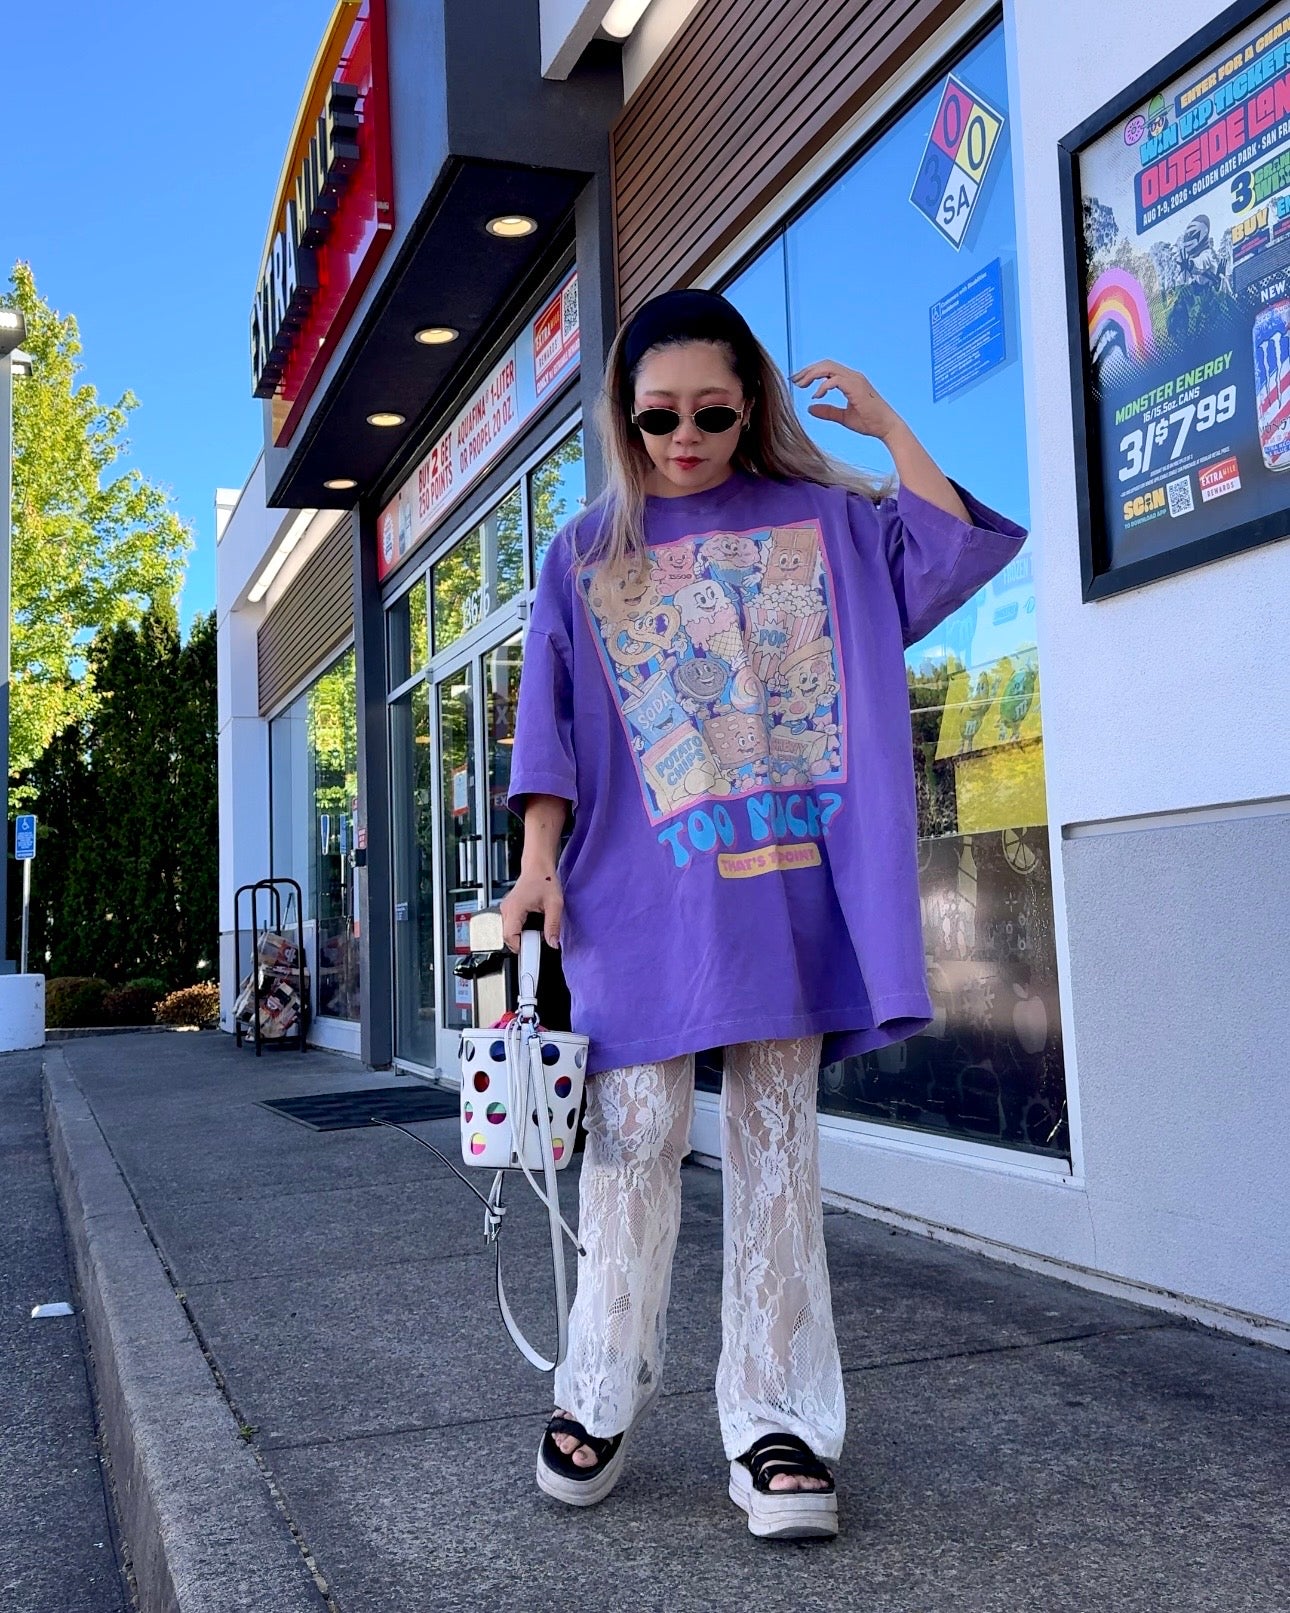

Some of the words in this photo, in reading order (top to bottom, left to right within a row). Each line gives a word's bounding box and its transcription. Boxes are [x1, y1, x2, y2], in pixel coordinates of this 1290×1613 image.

[1180, 73, 1217, 109] ENTER
[1218, 53, 1243, 80] FOR
[1245, 44, 1254, 62] A
[943, 94, 961, 148] 0
[967, 115, 986, 170] 0
[1141, 106, 1245, 208] OUTSIDE
[1143, 209, 1156, 226] AUG
[1170, 189, 1188, 208] 2026
[1192, 173, 1219, 196] GOLDEN
[1220, 159, 1237, 178] GATE
[1237, 142, 1257, 166] PARK
[1261, 129, 1277, 150] SAN
[925, 154, 941, 207] 3
[1231, 171, 1254, 215] 3
[943, 184, 970, 225] SA
[1231, 207, 1269, 245] BUY
[1260, 280, 1286, 302] NEW
[491, 360, 514, 406] 1-LITER
[1115, 381, 1174, 426] MONSTER
[1175, 351, 1233, 393] ENERGY
[1178, 386, 1201, 406] CANS
[418, 464, 430, 493] BUY
[431, 447, 438, 477] 2
[440, 432, 452, 467] GET
[460, 447, 468, 474] OR
[469, 426, 492, 459] PROPEL
[493, 410, 501, 437] 20
[431, 463, 453, 507] POINTS
[1123, 487, 1166, 521] SCAN
[1207, 482, 1235, 498] REWARDS
[758, 628, 786, 650] POP
[637, 690, 674, 730] SODA
[655, 735, 703, 778] POTATO
[667, 748, 706, 786] CHIPS
[658, 804, 735, 868] TOO
[720, 855, 766, 872] THAT'S
